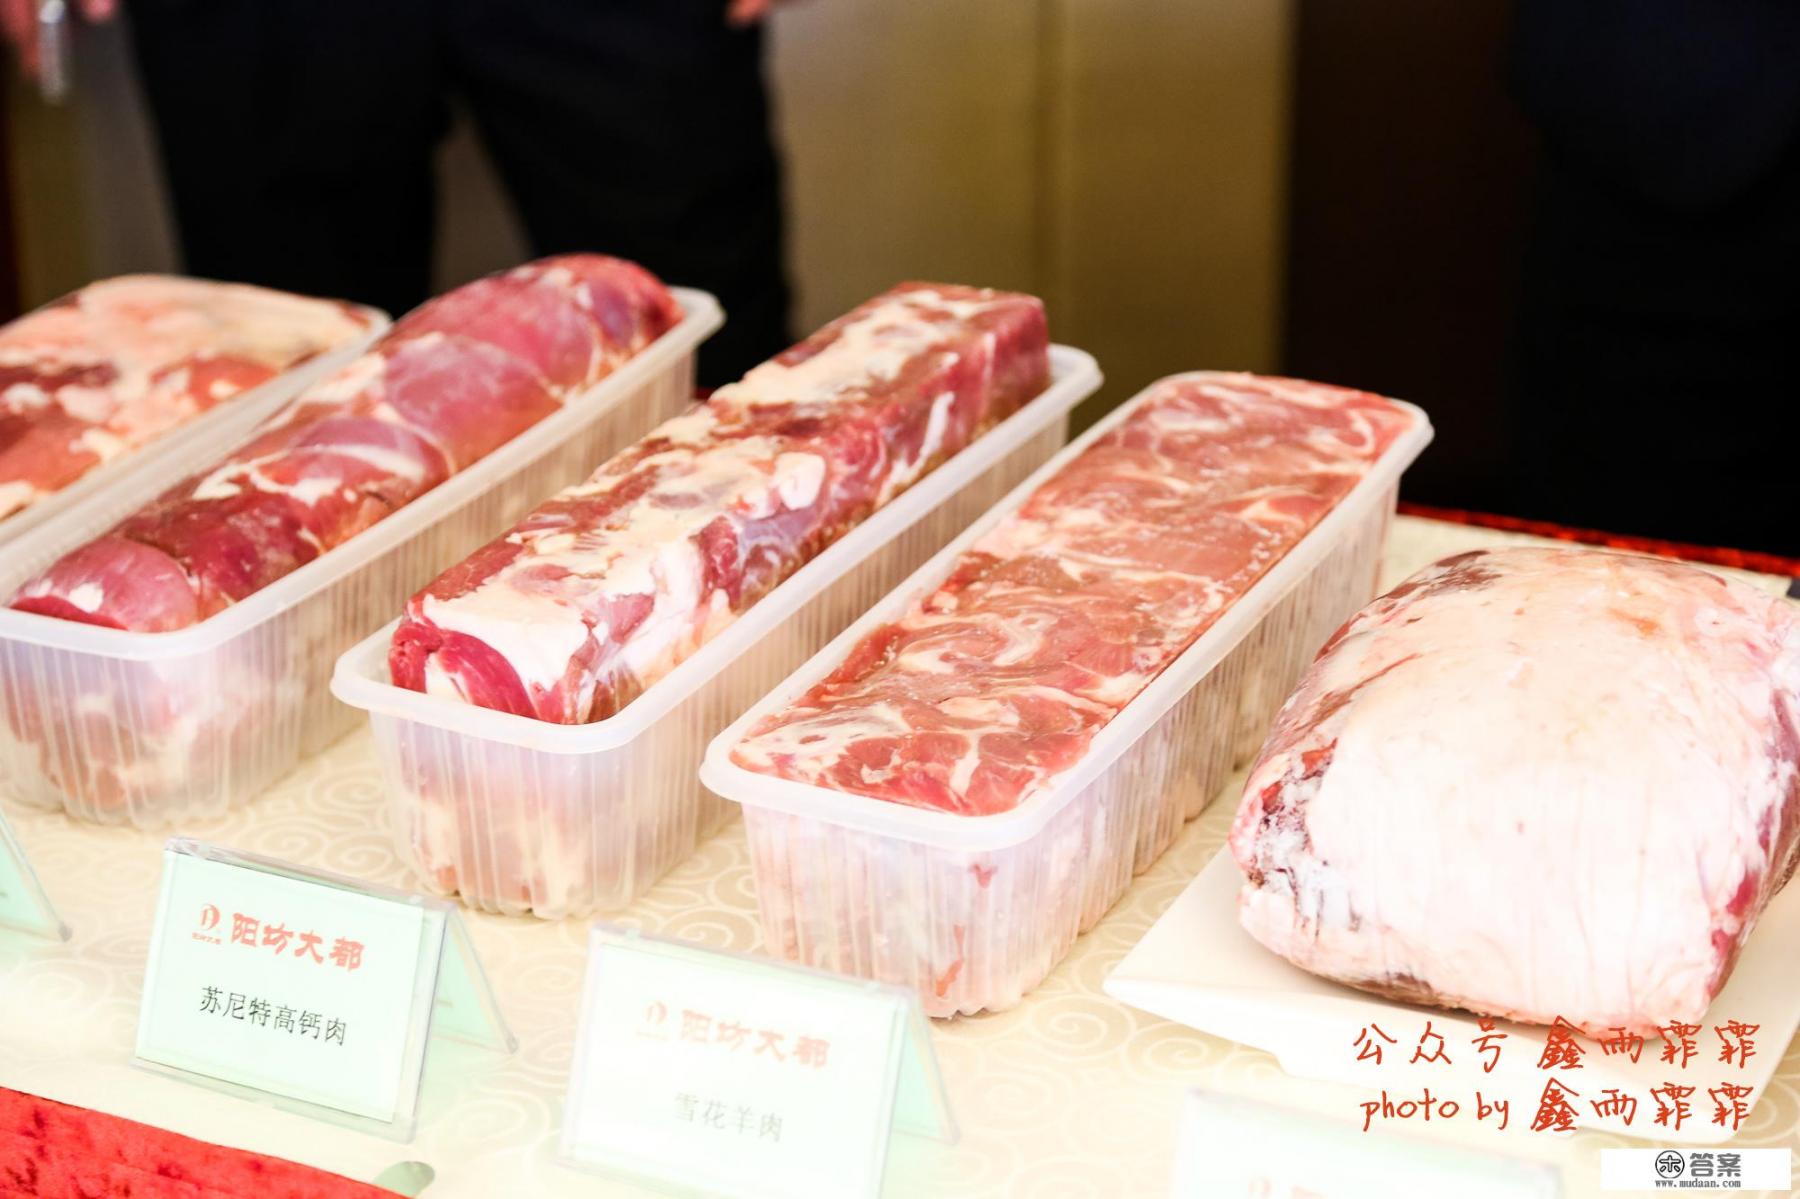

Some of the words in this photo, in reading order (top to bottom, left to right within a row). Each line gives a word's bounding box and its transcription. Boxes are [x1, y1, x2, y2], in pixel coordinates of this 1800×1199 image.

[199, 985, 348, 1047] 苏尼特高钙肉
[674, 1092, 784, 1143] 雪花羊肉
